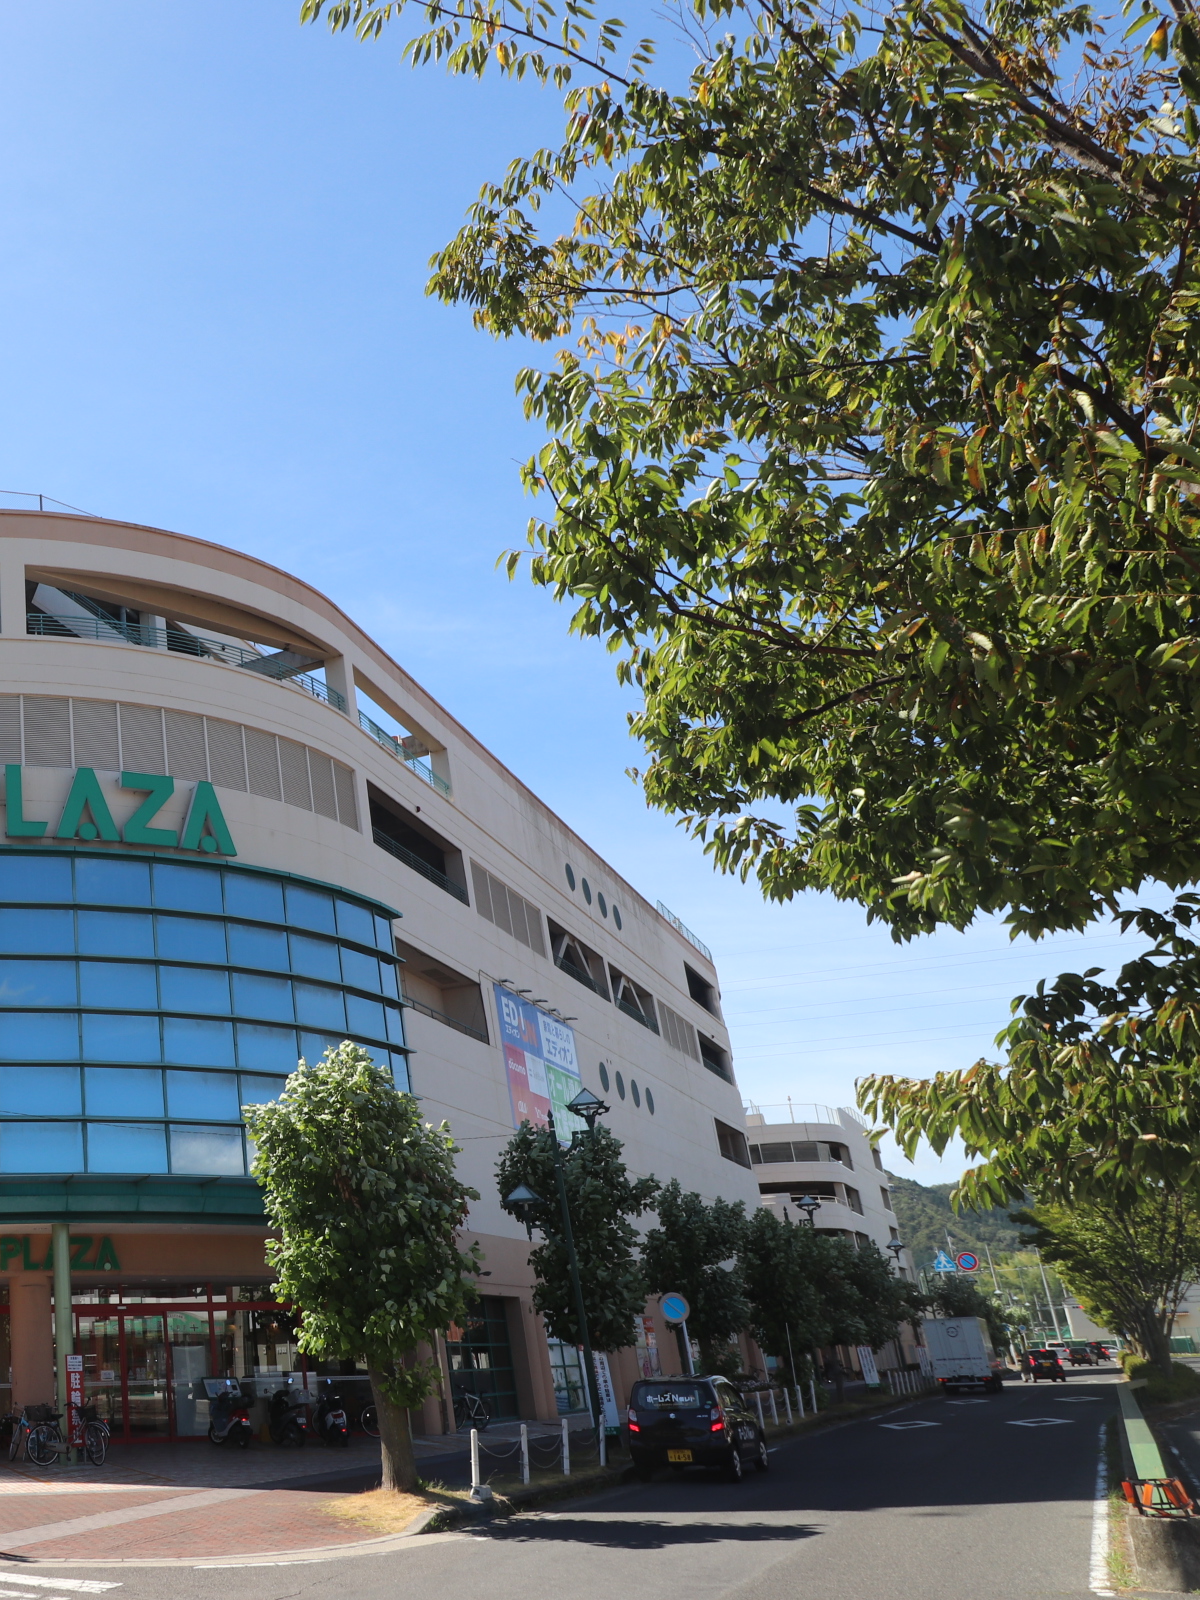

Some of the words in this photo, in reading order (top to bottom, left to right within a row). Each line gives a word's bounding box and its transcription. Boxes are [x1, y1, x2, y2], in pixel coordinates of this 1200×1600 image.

[545, 1037, 573, 1066] エディオン
